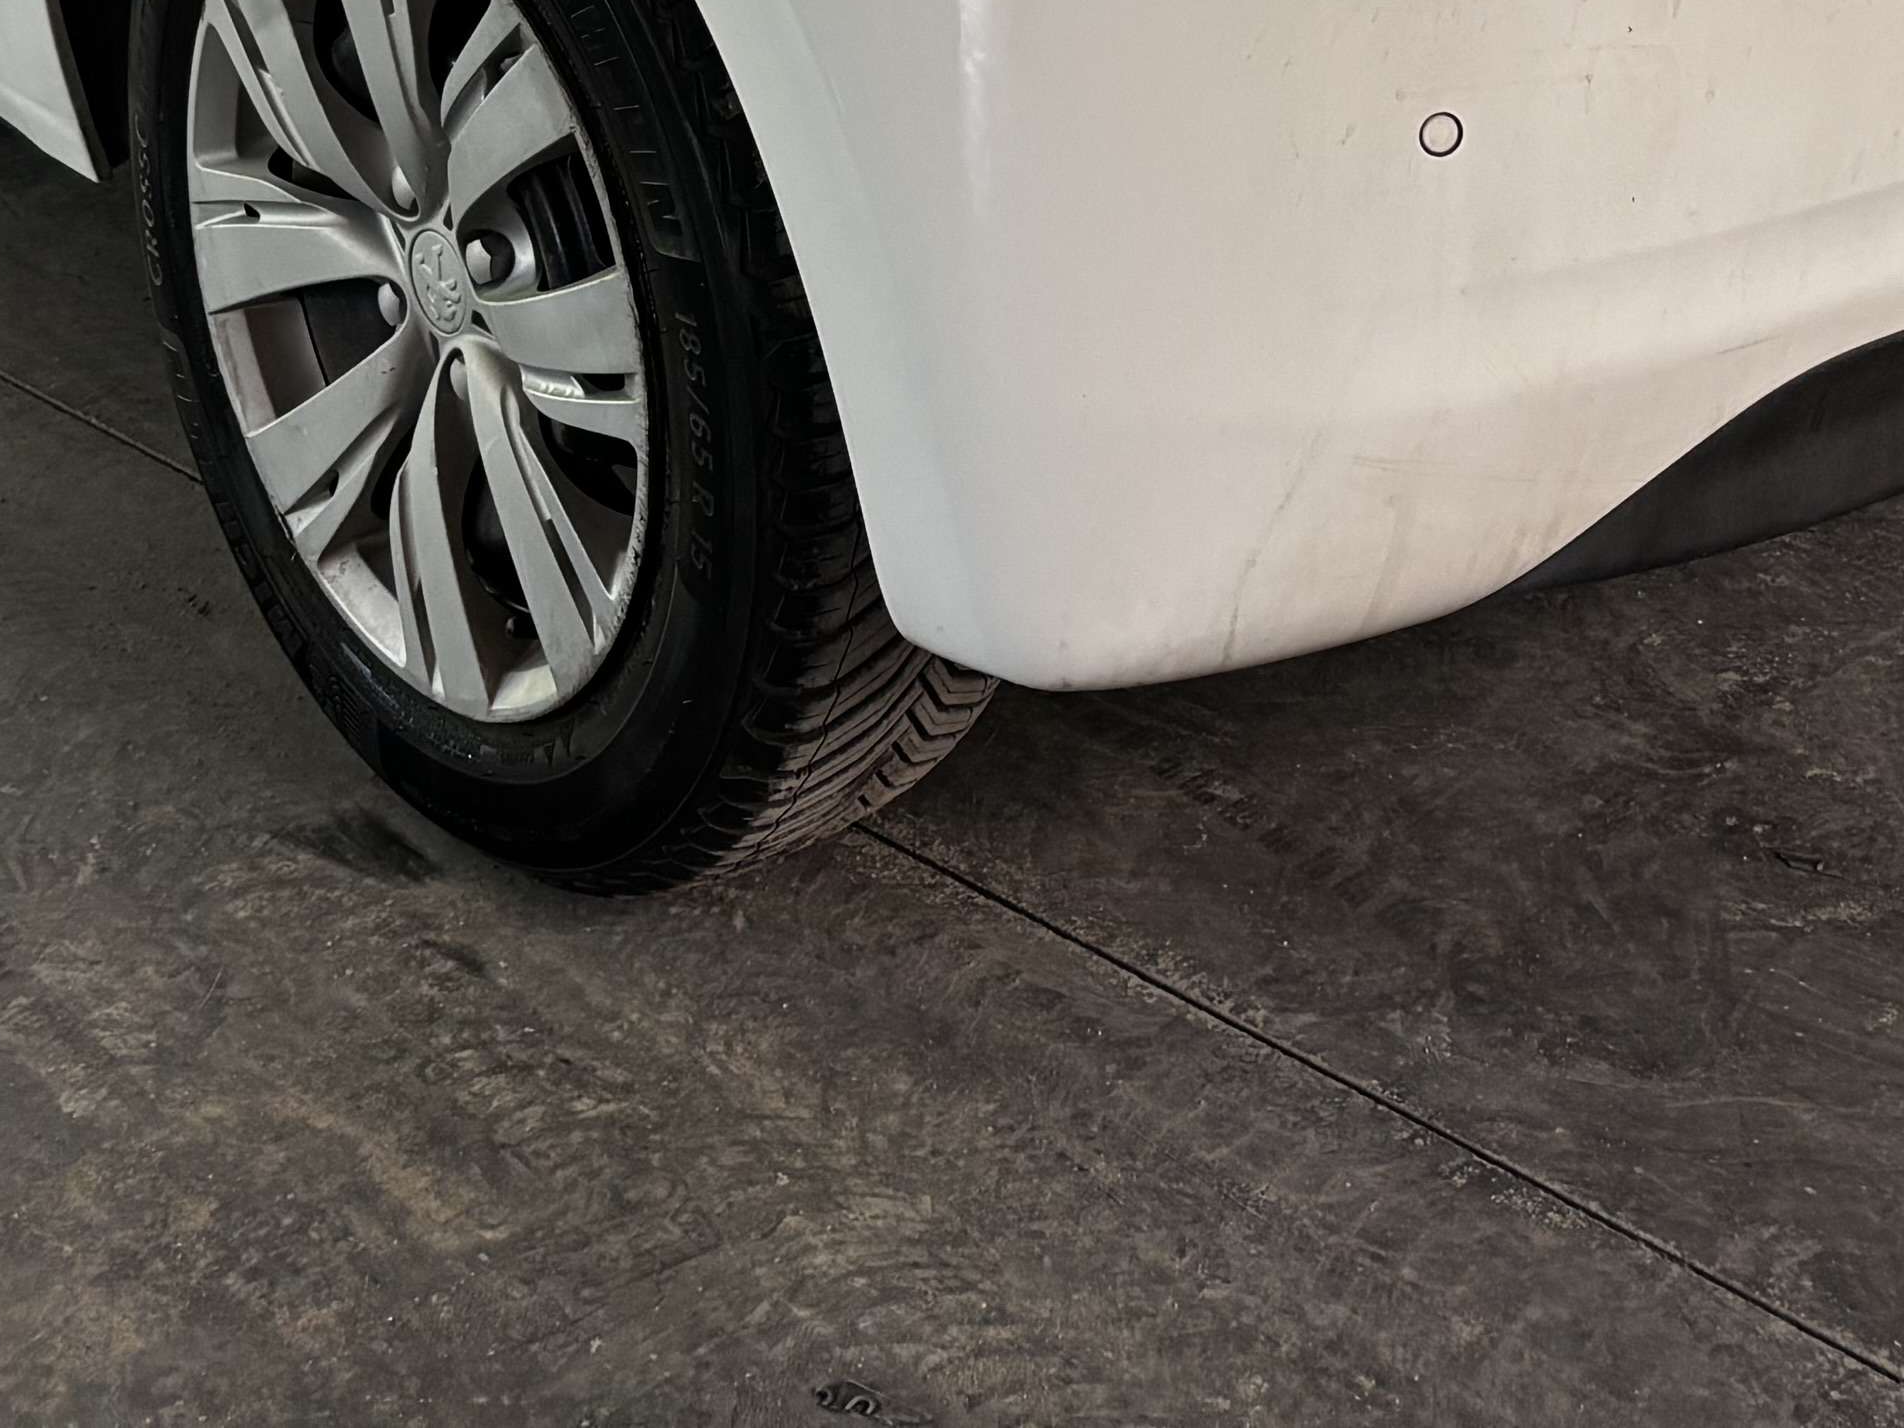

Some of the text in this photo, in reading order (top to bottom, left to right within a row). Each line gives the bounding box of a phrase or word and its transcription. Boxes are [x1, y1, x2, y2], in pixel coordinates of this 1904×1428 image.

[674, 310, 716, 582] 185/65 R 15
